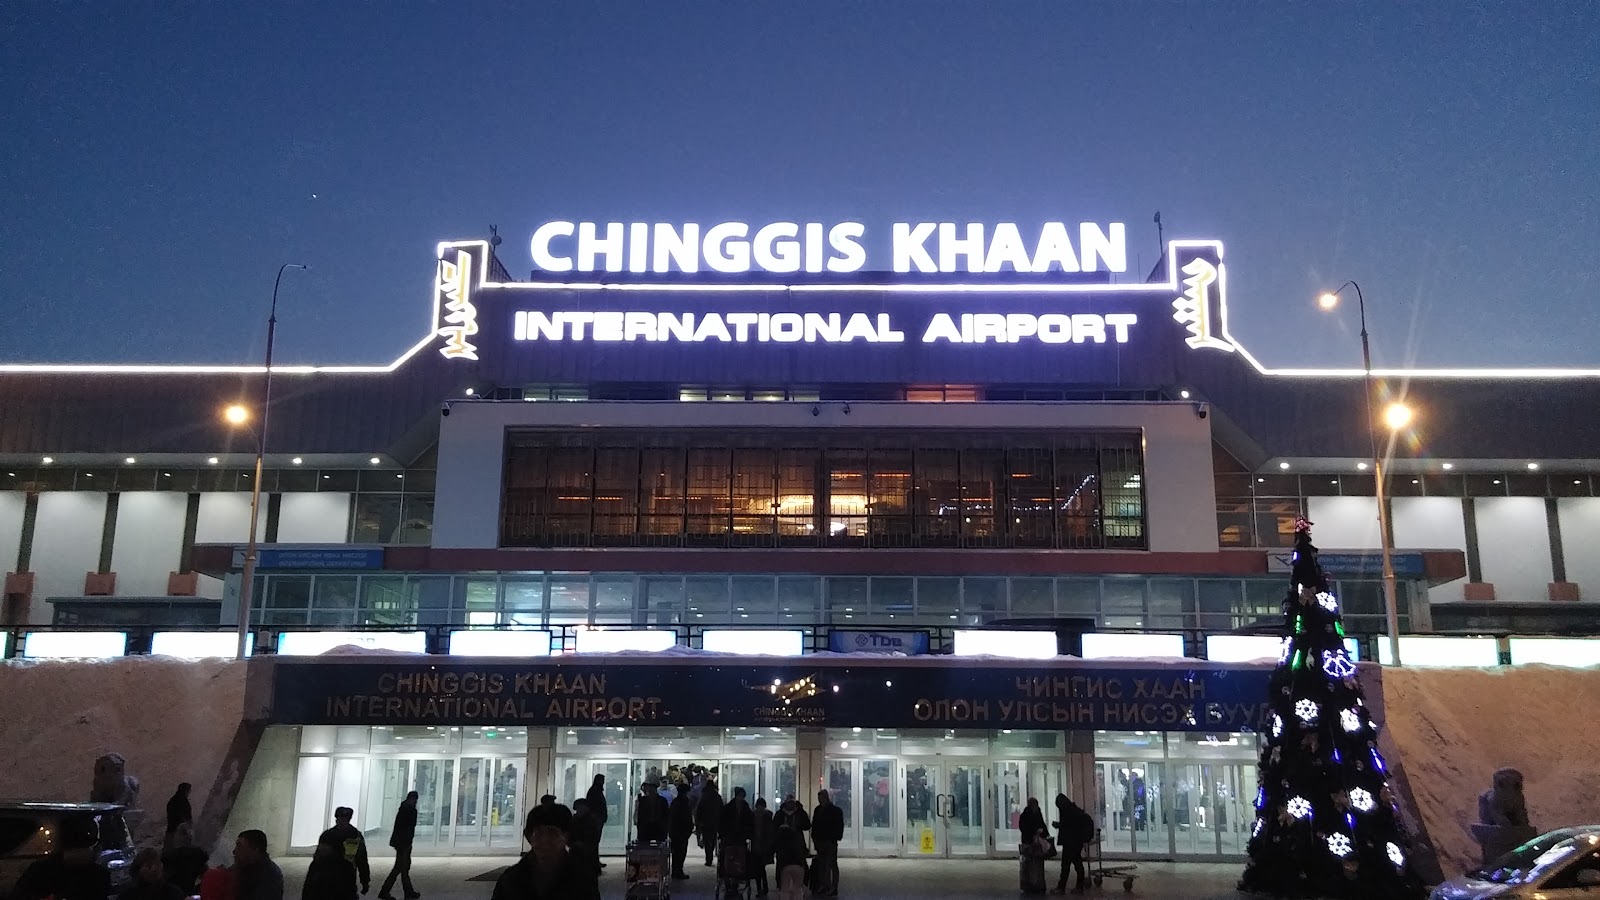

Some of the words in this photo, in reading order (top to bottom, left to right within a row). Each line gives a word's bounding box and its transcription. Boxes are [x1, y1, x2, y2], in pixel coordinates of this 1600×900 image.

[531, 221, 866, 274] CHINGGIS
[893, 222, 1127, 273] KHAAN
[514, 311, 905, 343] INTERNATIONAL
[922, 313, 1137, 344] AIRPORT
[870, 635, 902, 647] TDB
[378, 673, 504, 694] CHINGGIS
[514, 673, 606, 695] KHAAN
[1015, 676, 1122, 698] ЧИНГИС
[1133, 677, 1205, 699] ХААН
[326, 696, 534, 719] INTERNATIONAL
[545, 696, 662, 720] AIRPORT
[913, 698, 989, 721] ОЛОН
[999, 701, 1095, 723] УЛСЫН
[1103, 702, 1196, 725] НИСЭХ
[1204, 703, 1271, 727] БУУД
